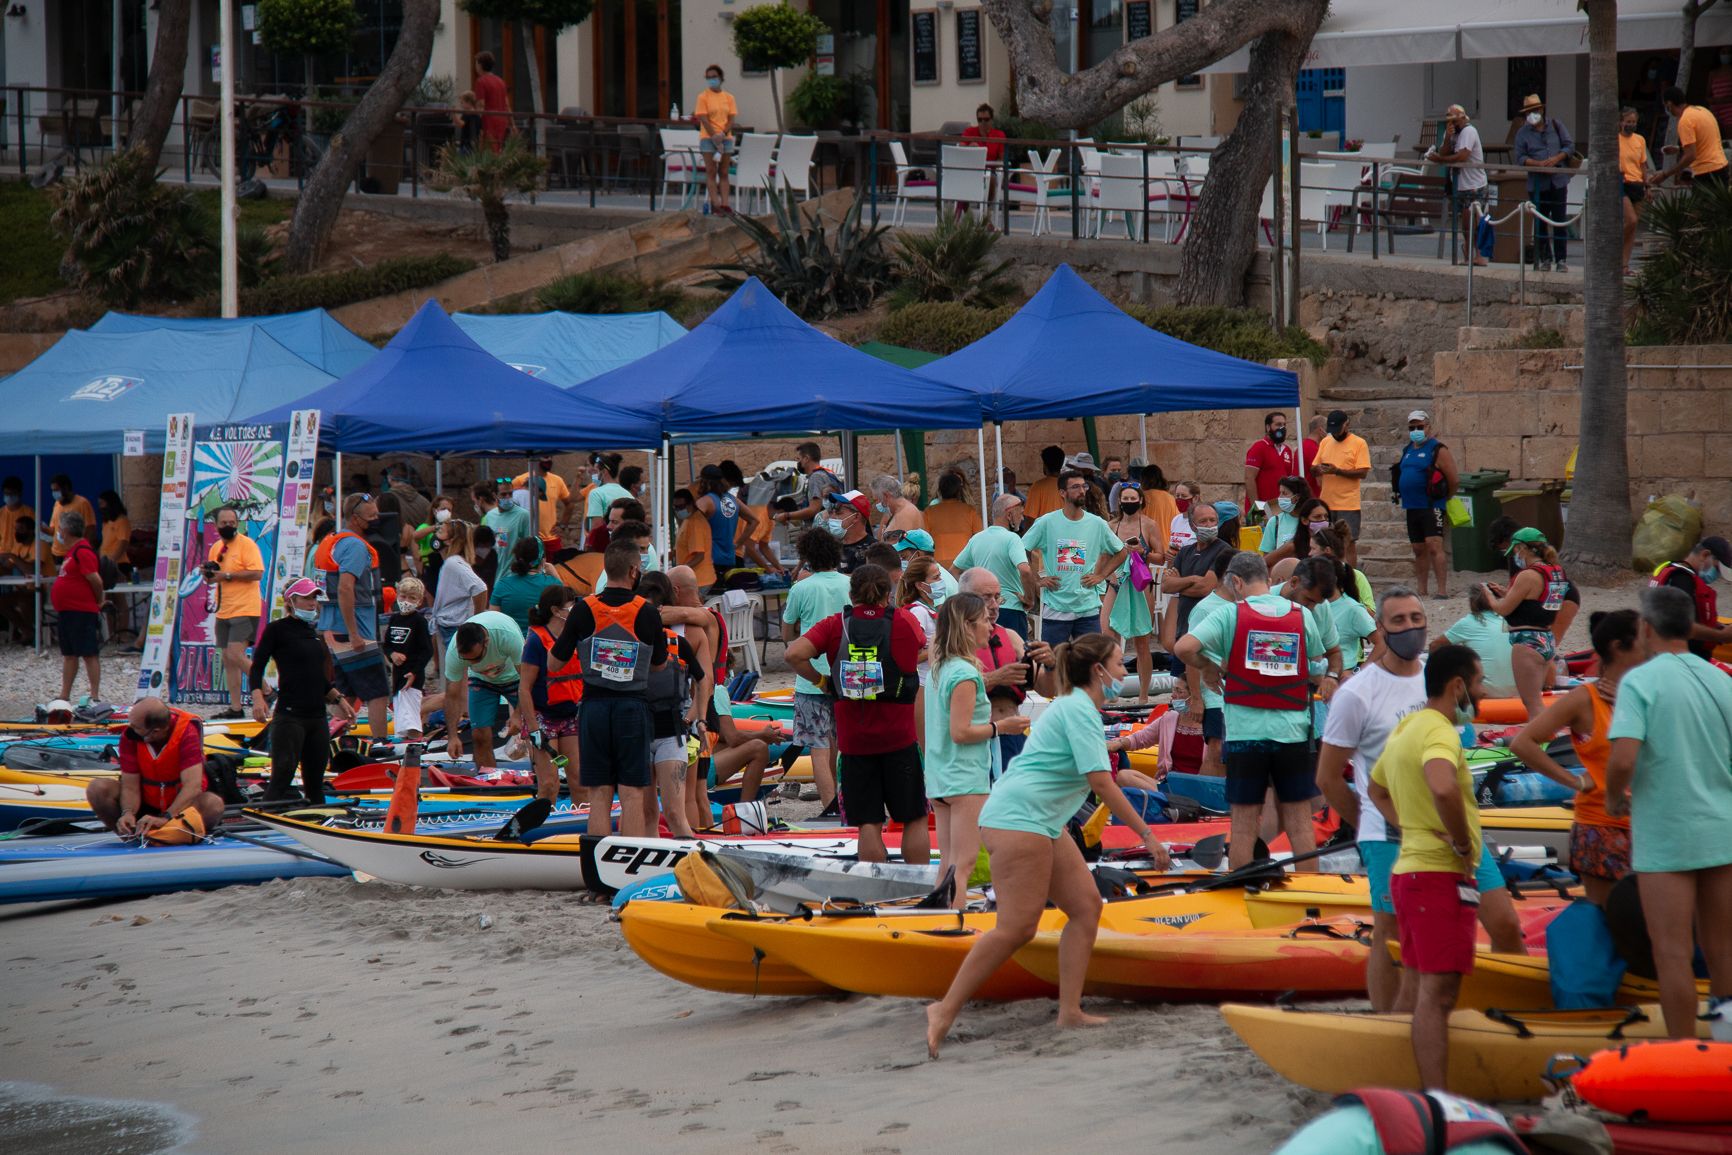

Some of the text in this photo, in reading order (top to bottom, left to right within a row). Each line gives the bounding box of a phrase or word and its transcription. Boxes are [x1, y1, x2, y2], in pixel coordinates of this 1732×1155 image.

[606, 666, 619, 674] 408
[1265, 662, 1279, 670] 110
[601, 845, 692, 875] epi
[1154, 915, 1183, 926] OCEAN
